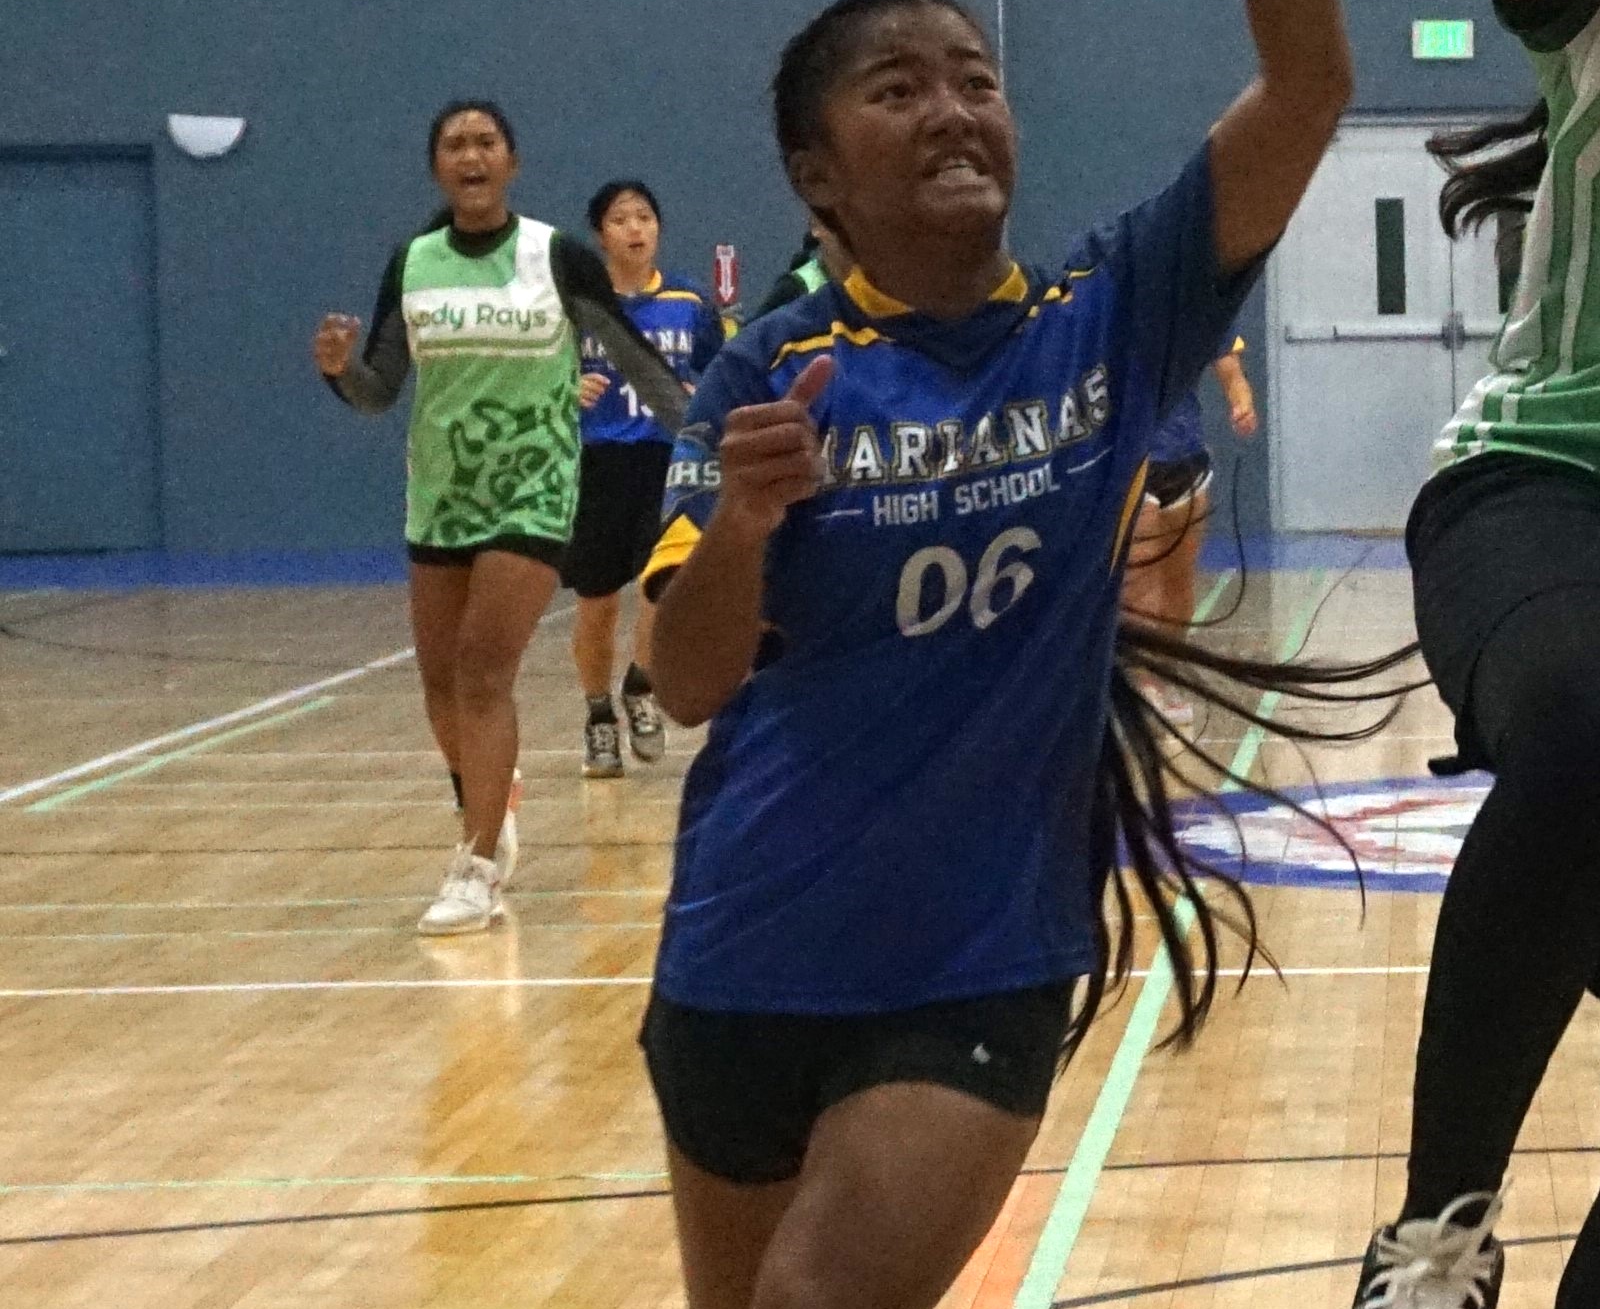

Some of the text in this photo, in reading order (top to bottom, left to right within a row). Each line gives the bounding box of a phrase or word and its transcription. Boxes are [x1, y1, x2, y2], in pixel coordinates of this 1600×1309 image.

[476, 302, 547, 332] Rays
[872, 462, 1061, 527] HIGH SCHOOL
[896, 526, 1042, 637] 06
